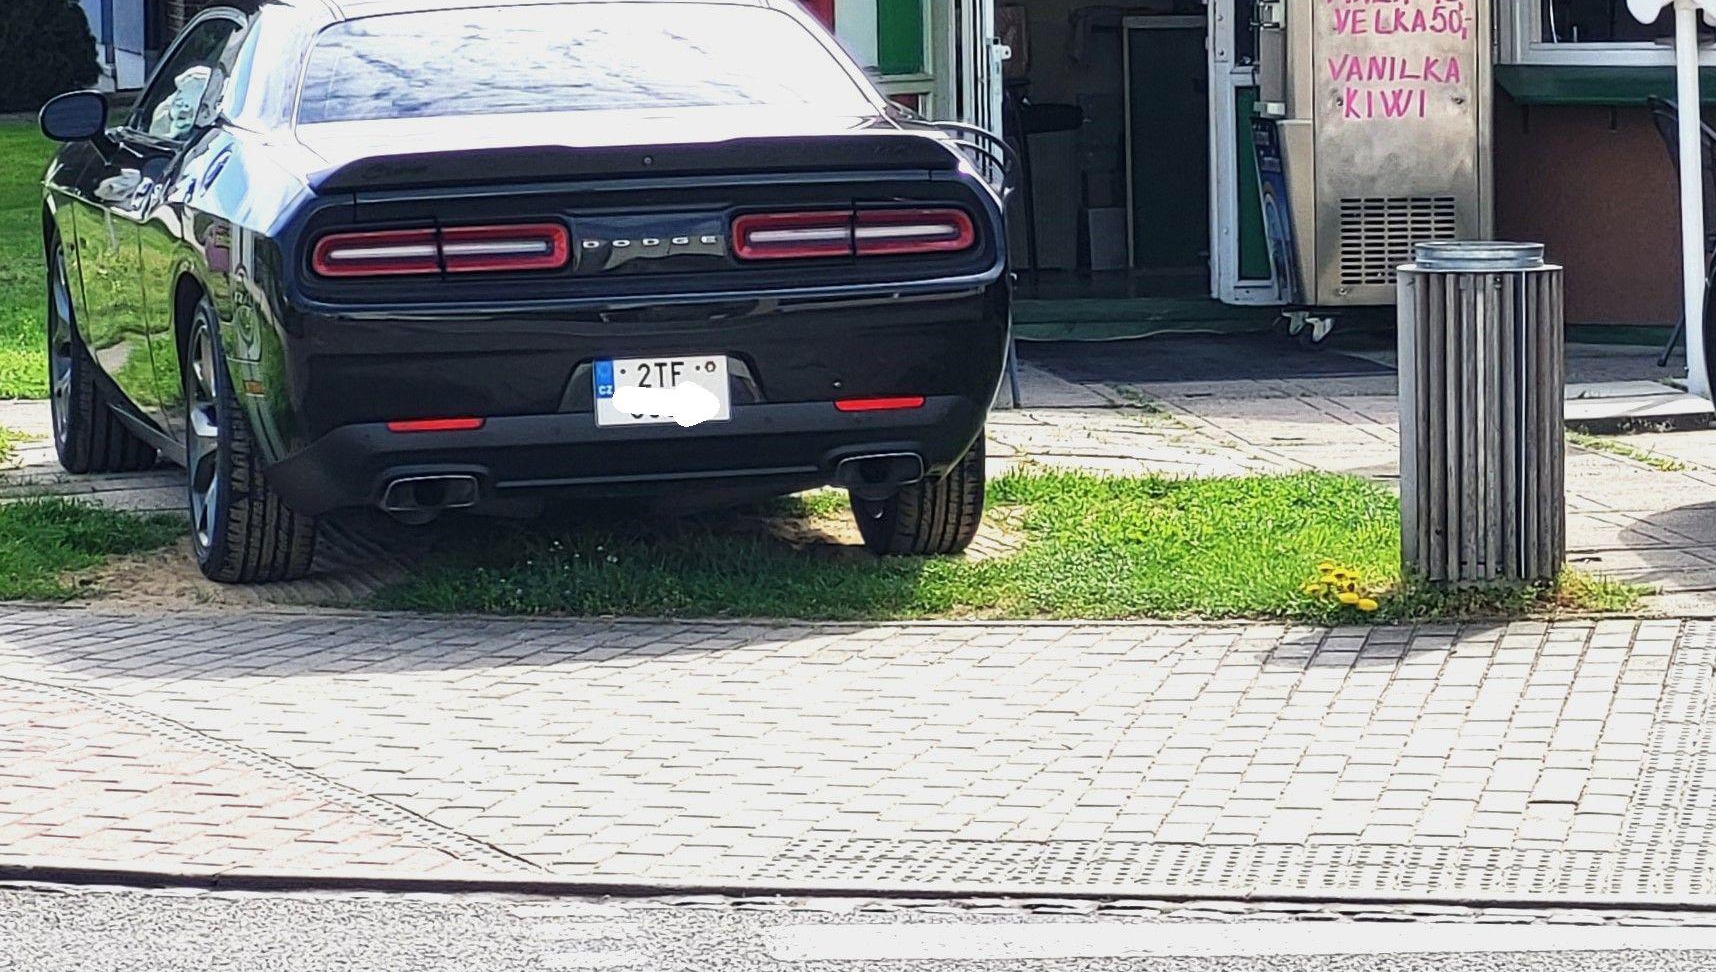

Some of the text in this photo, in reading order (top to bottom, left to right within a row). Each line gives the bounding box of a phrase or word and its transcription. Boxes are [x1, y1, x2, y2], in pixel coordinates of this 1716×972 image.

[1334, 7, 1427, 35] VELKA
[1328, 54, 1461, 84] VANILKA
[1344, 88, 1426, 119] KIWI
[582, 235, 718, 249] DODGE
[637, 361, 685, 389] 2TF
[598, 385, 613, 396] CZ
